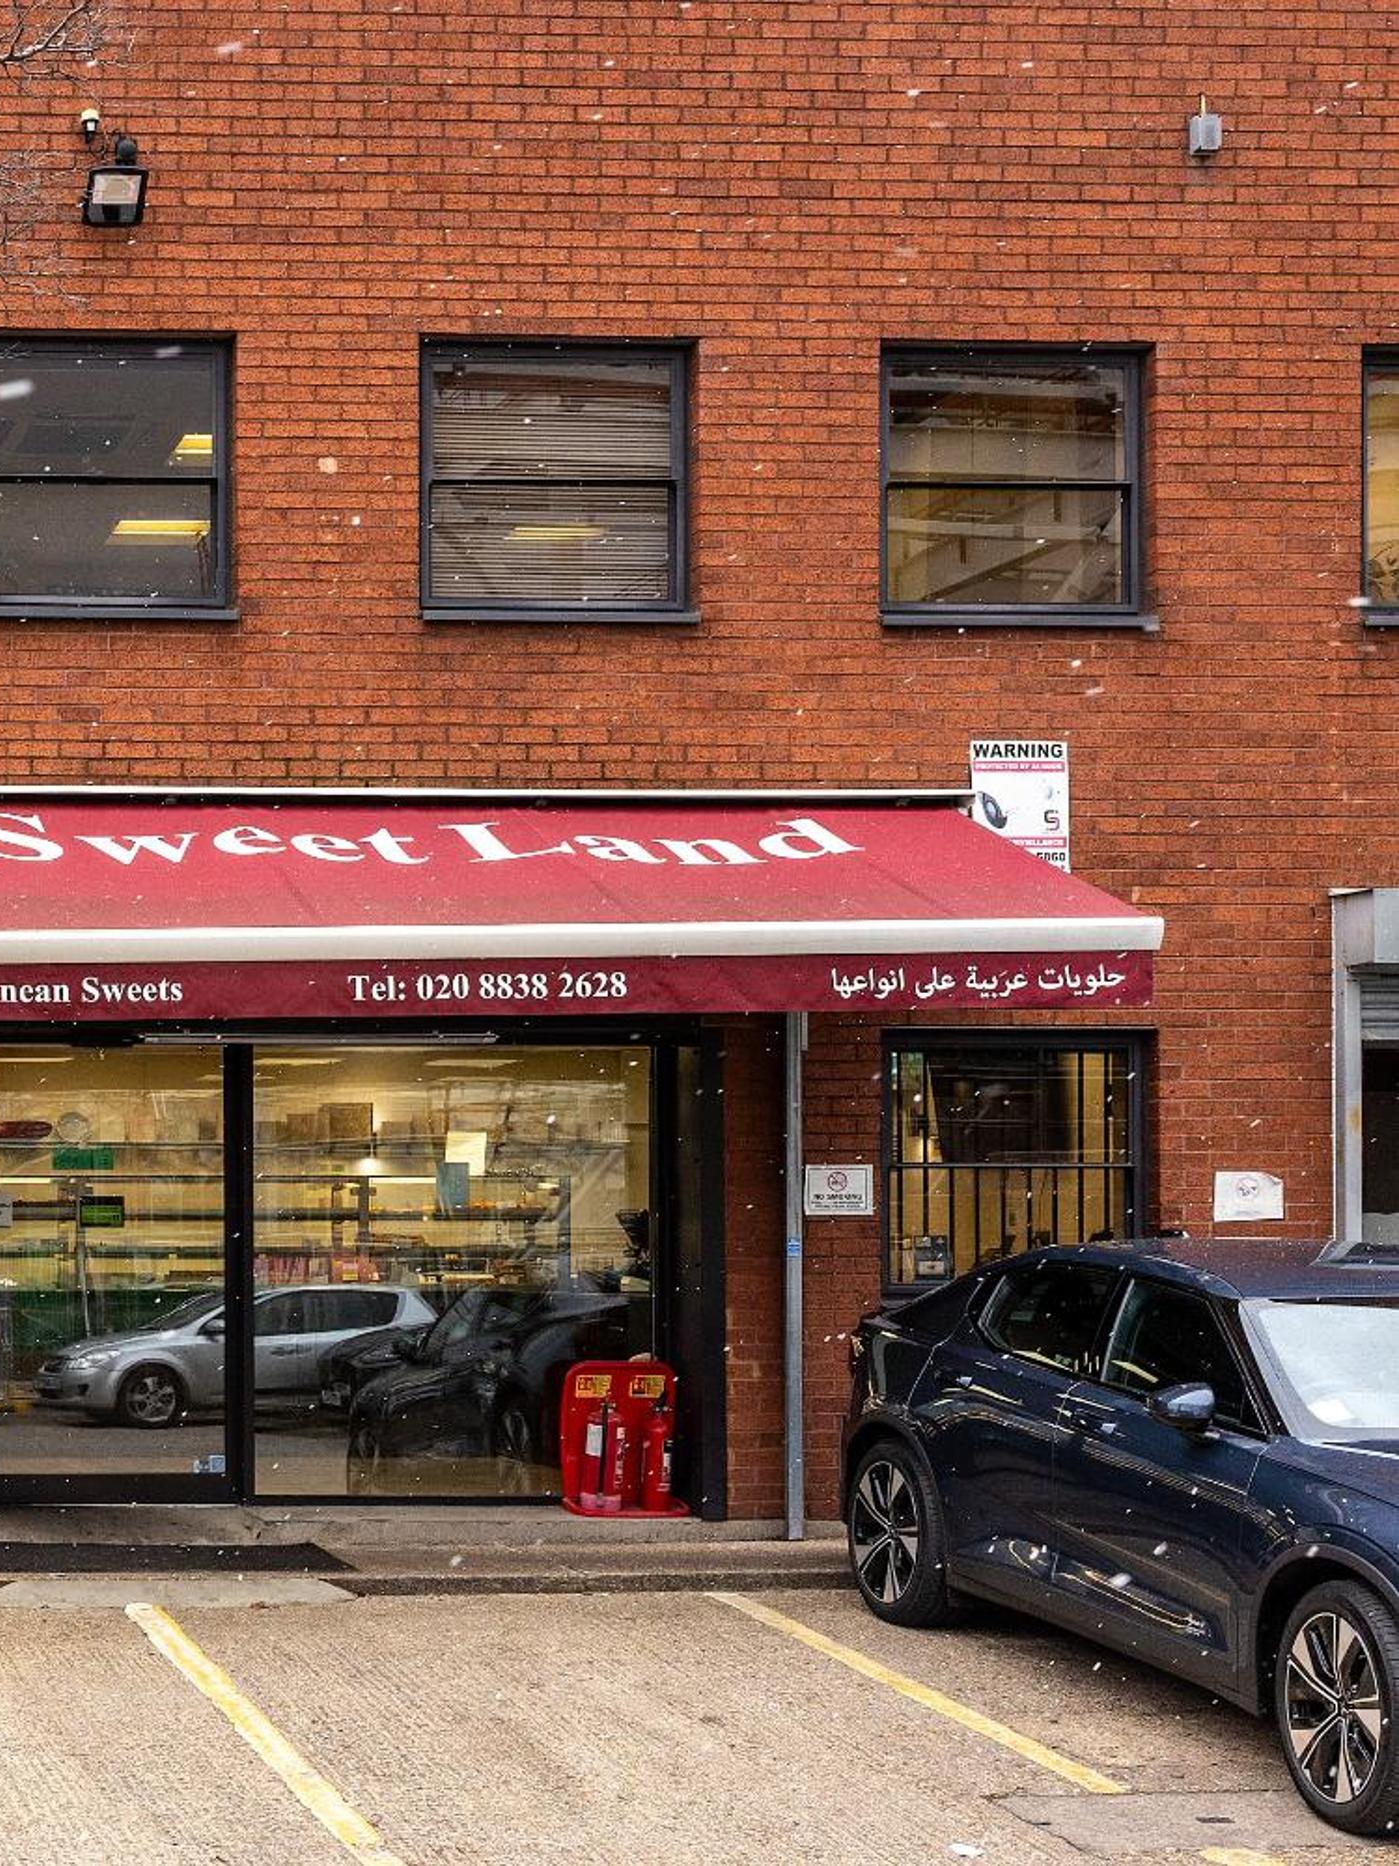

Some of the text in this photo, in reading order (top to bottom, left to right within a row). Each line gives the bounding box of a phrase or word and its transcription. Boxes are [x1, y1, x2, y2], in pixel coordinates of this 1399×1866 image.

[973, 744, 1063, 758] WARNING
[438, 818, 865, 866] Land
[81, 977, 183, 1003] Sweets
[347, 972, 628, 1001] Tel: 020 8838 2628
[1038, 965, 1126, 996] حلويات
